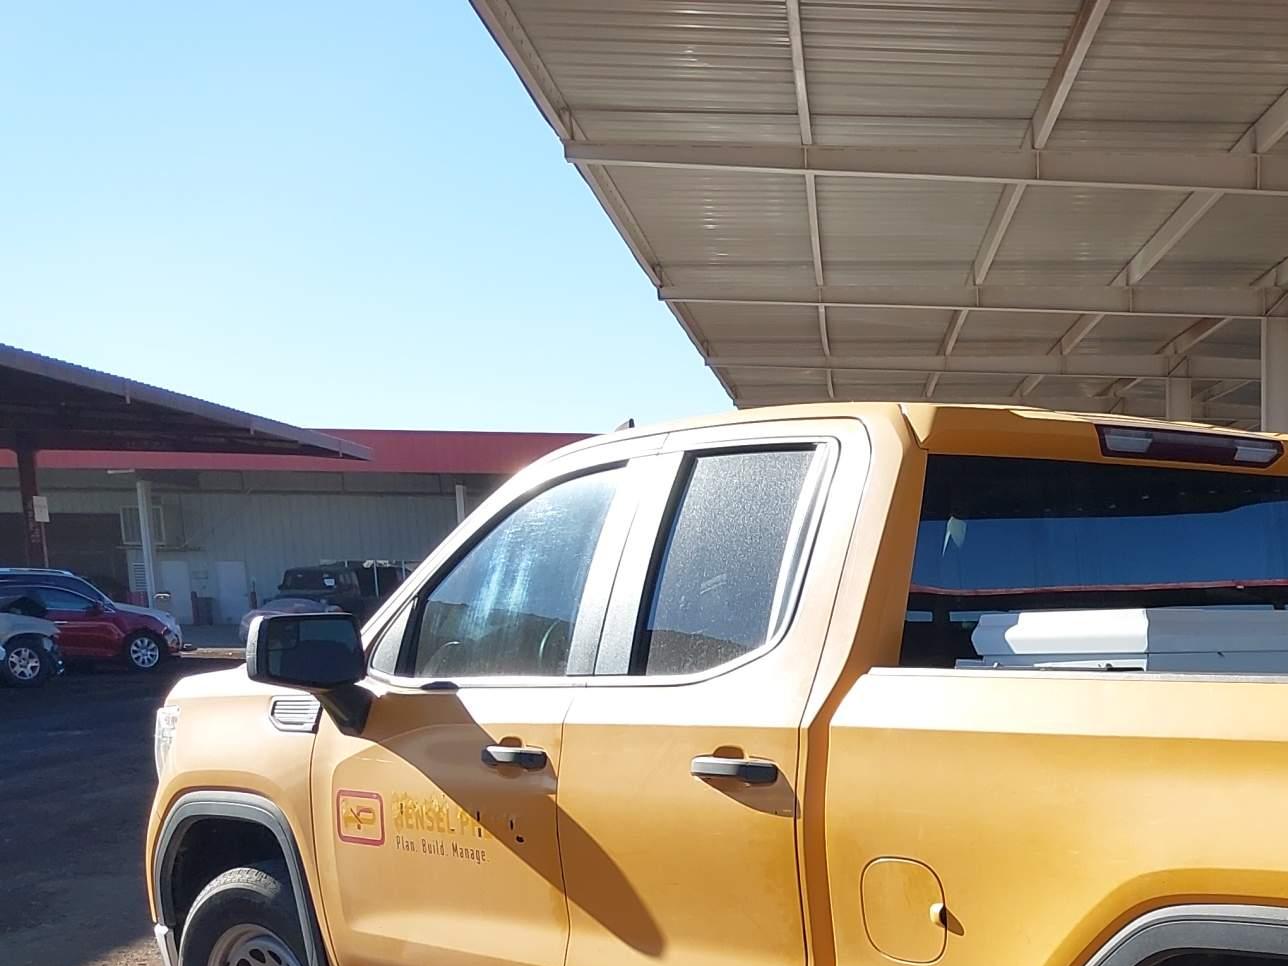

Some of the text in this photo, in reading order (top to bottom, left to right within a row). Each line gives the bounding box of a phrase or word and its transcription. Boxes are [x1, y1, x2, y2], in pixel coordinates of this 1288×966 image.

[396, 835, 490, 864] Plan. Build. Manage.
